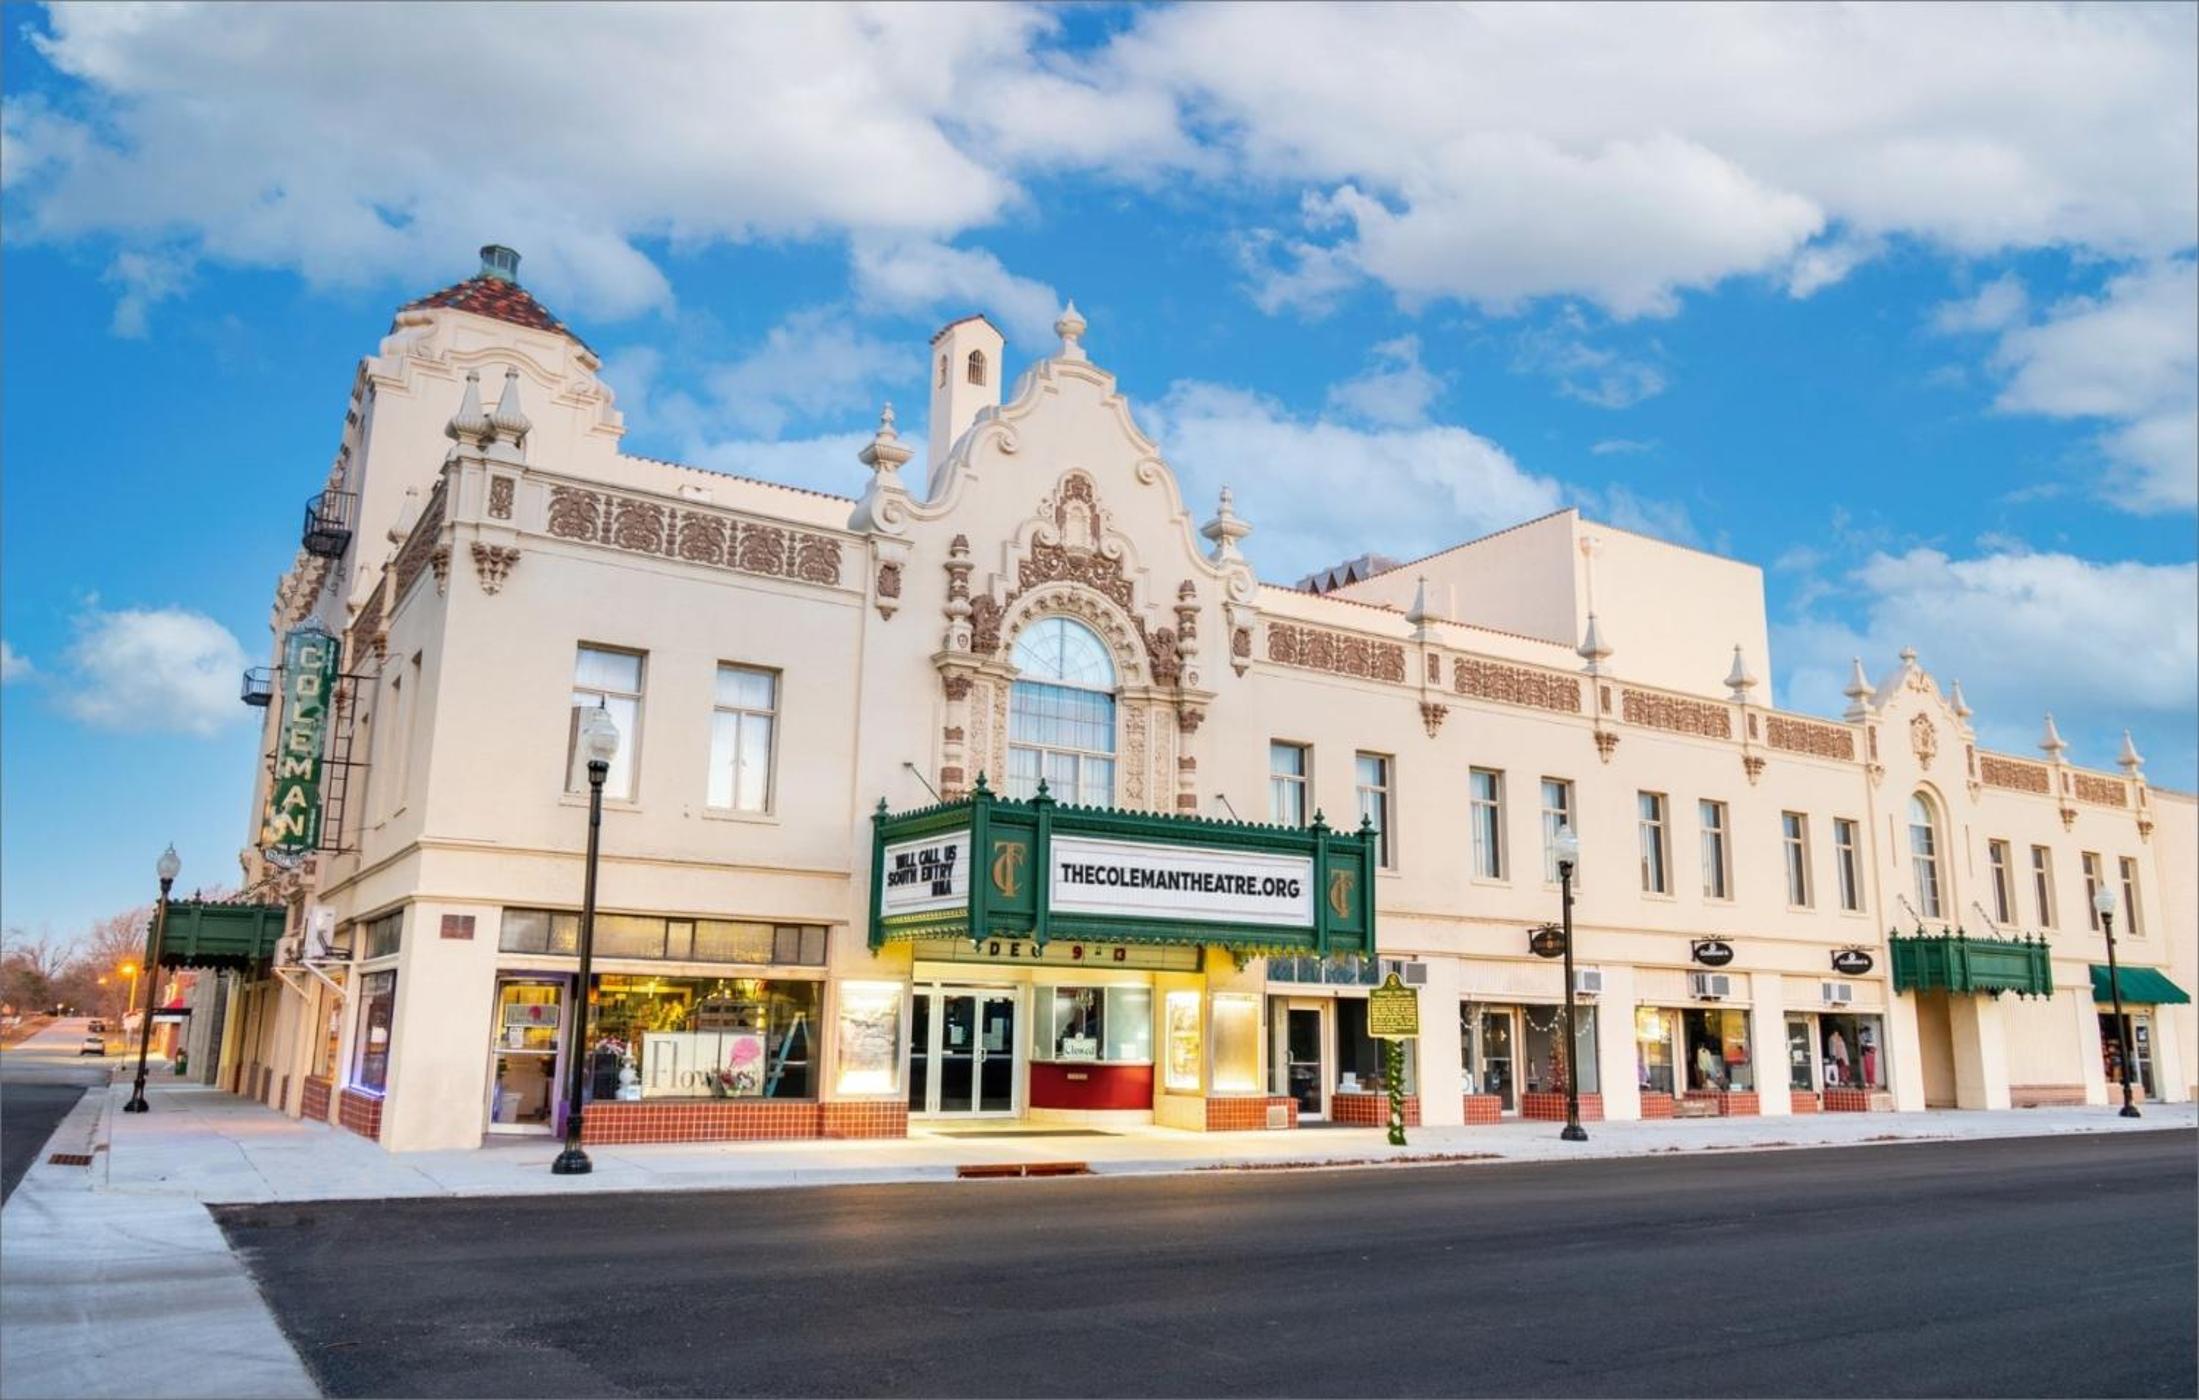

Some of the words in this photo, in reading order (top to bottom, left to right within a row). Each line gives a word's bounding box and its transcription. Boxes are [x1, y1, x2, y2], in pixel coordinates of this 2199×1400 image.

[273, 646, 323, 838] COLEMAN
[887, 867, 918, 887] SOUTH
[921, 861, 953, 882] ENTRY
[895, 852, 917, 870] WILL
[919, 847, 941, 865] CALL
[1060, 862, 1301, 899] THECOLEMANTHEATRE.ORG
